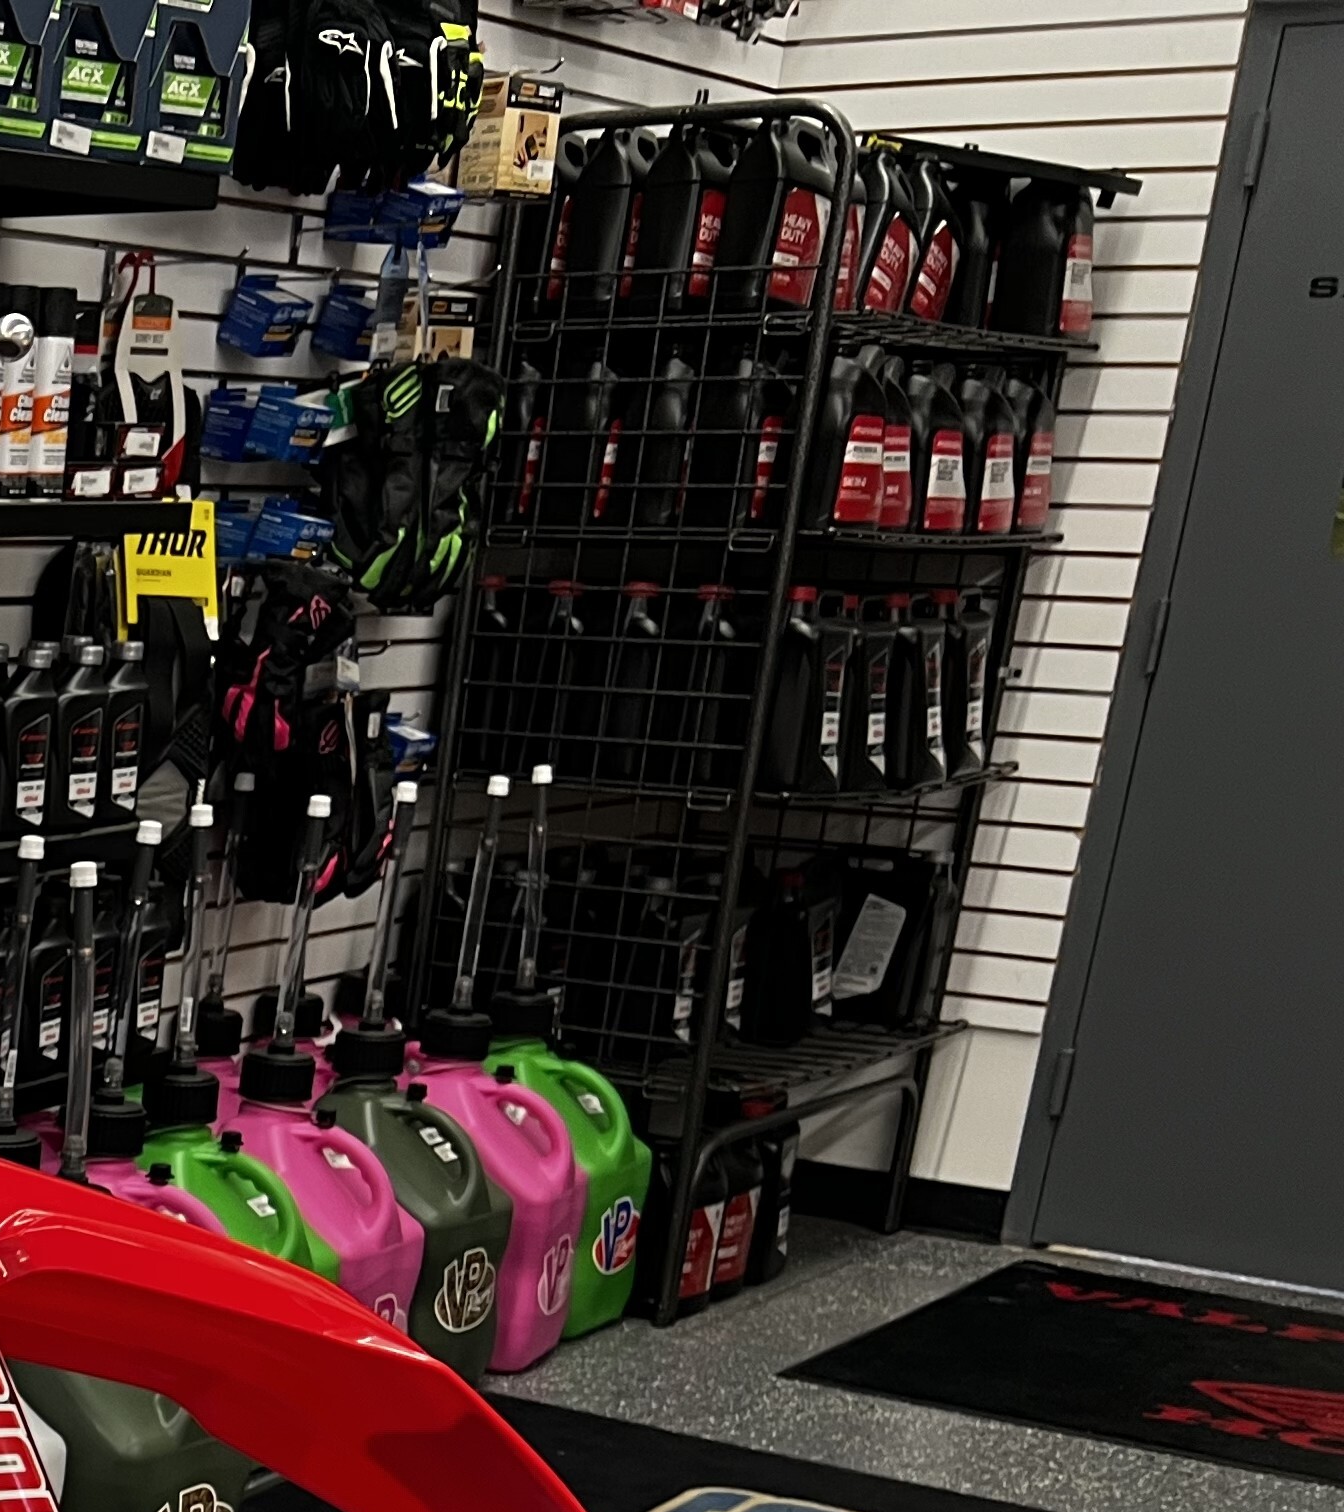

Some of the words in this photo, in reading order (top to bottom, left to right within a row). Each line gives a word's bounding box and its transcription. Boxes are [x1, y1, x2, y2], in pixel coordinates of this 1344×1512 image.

[67, 66, 104, 84] ACX
[166, 81, 202, 98] ACX
[783, 213, 812, 231] HEAVY
[780, 227, 806, 244] DUTY
[136, 529, 207, 559] THOR
